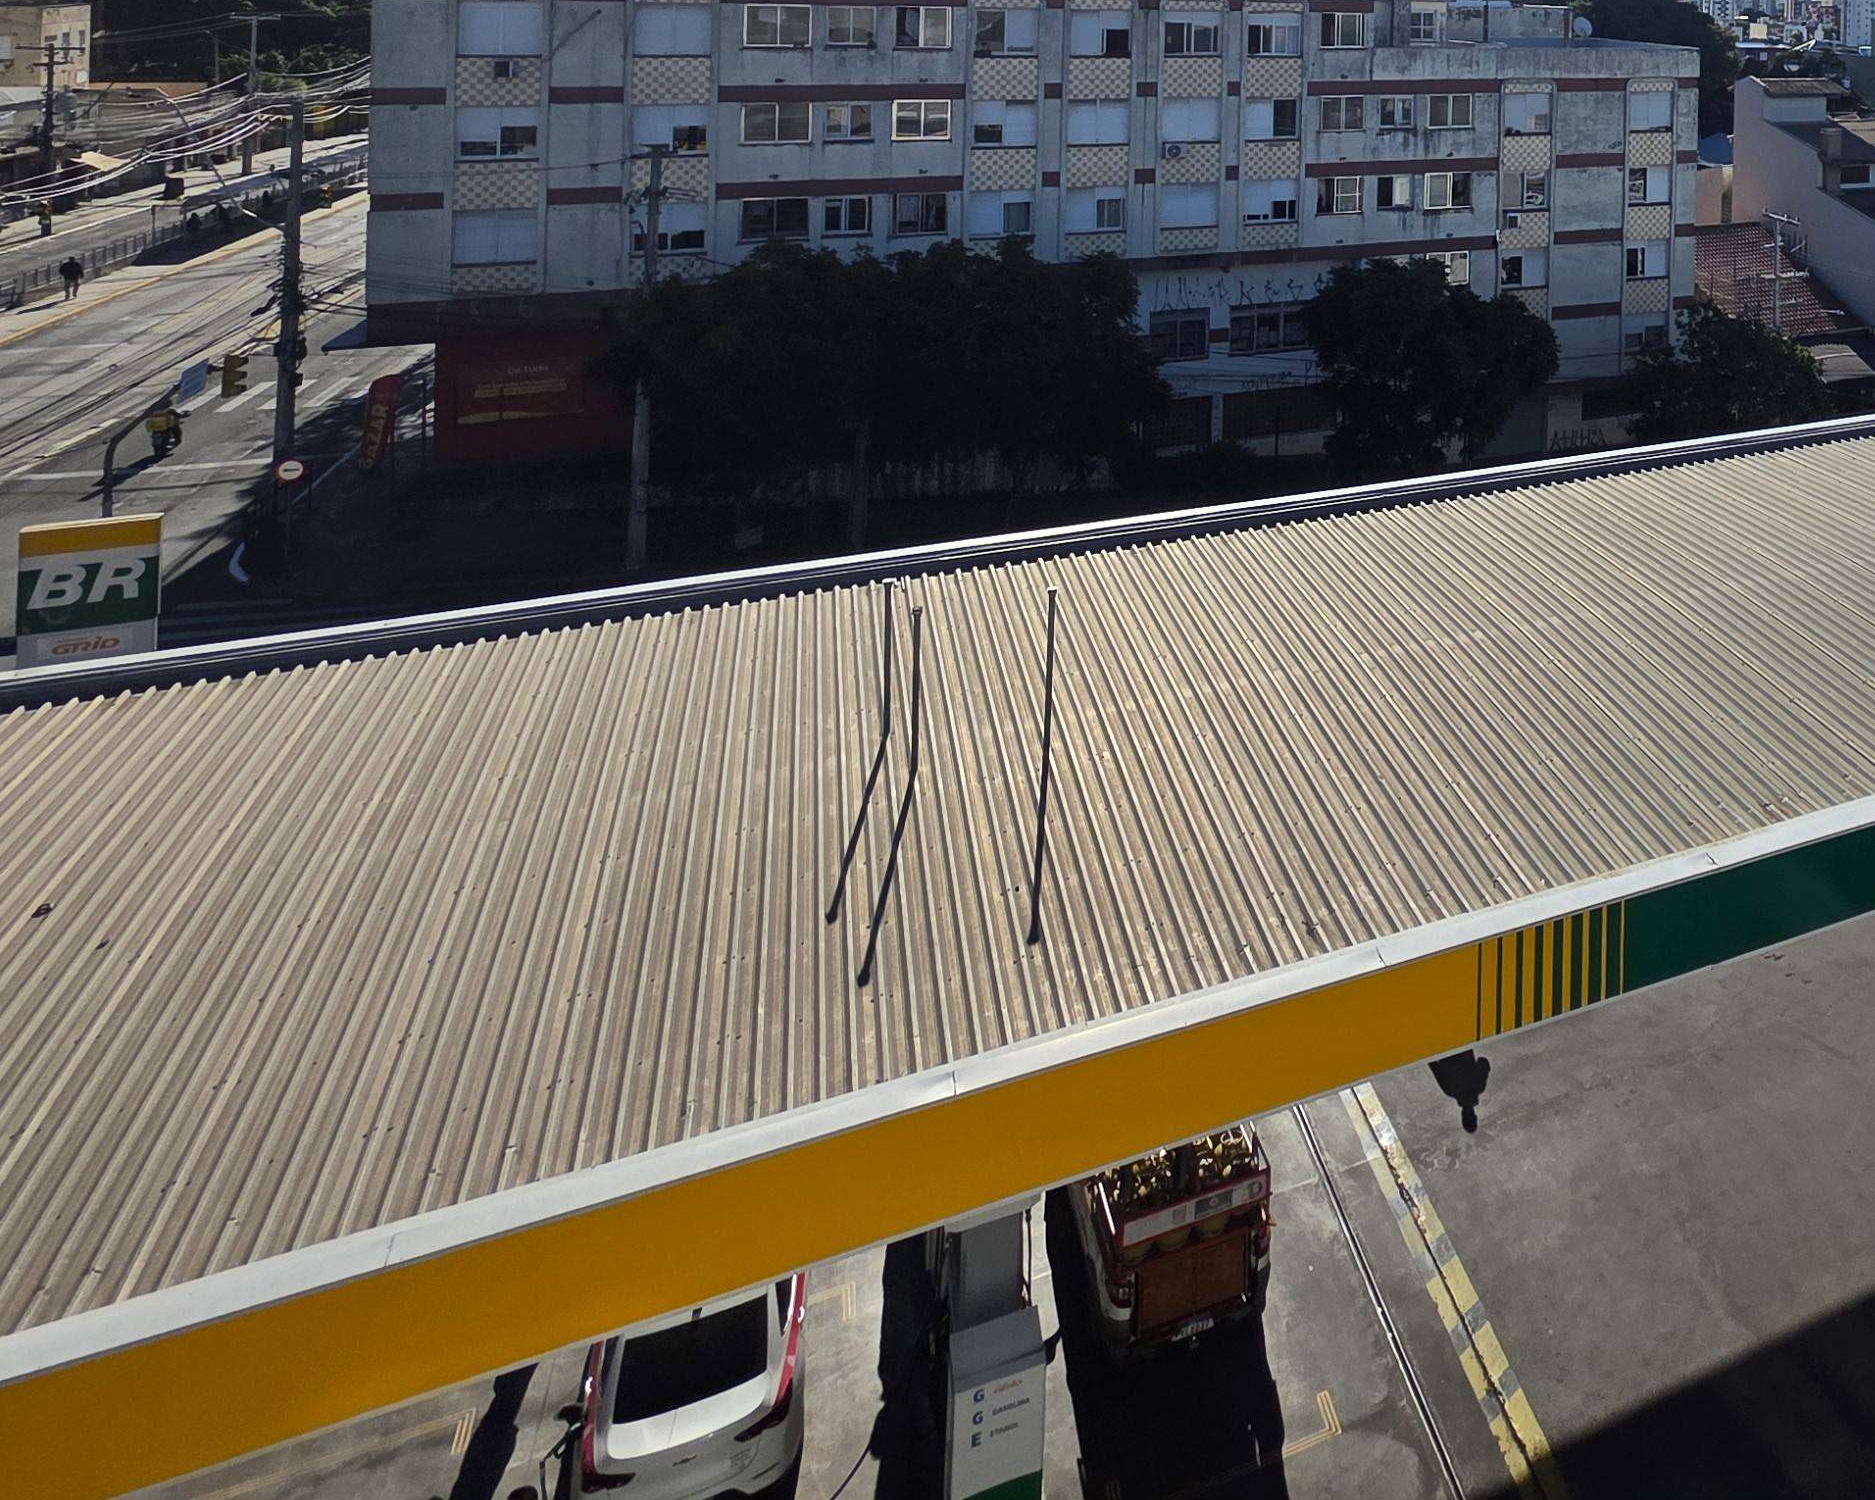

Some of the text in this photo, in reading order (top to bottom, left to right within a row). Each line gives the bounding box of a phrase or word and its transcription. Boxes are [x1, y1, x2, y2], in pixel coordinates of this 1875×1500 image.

[26, 558, 146, 611] BR
[973, 1388, 985, 1403] G
[972, 1410, 984, 1425] G
[970, 1431, 982, 1448] E
